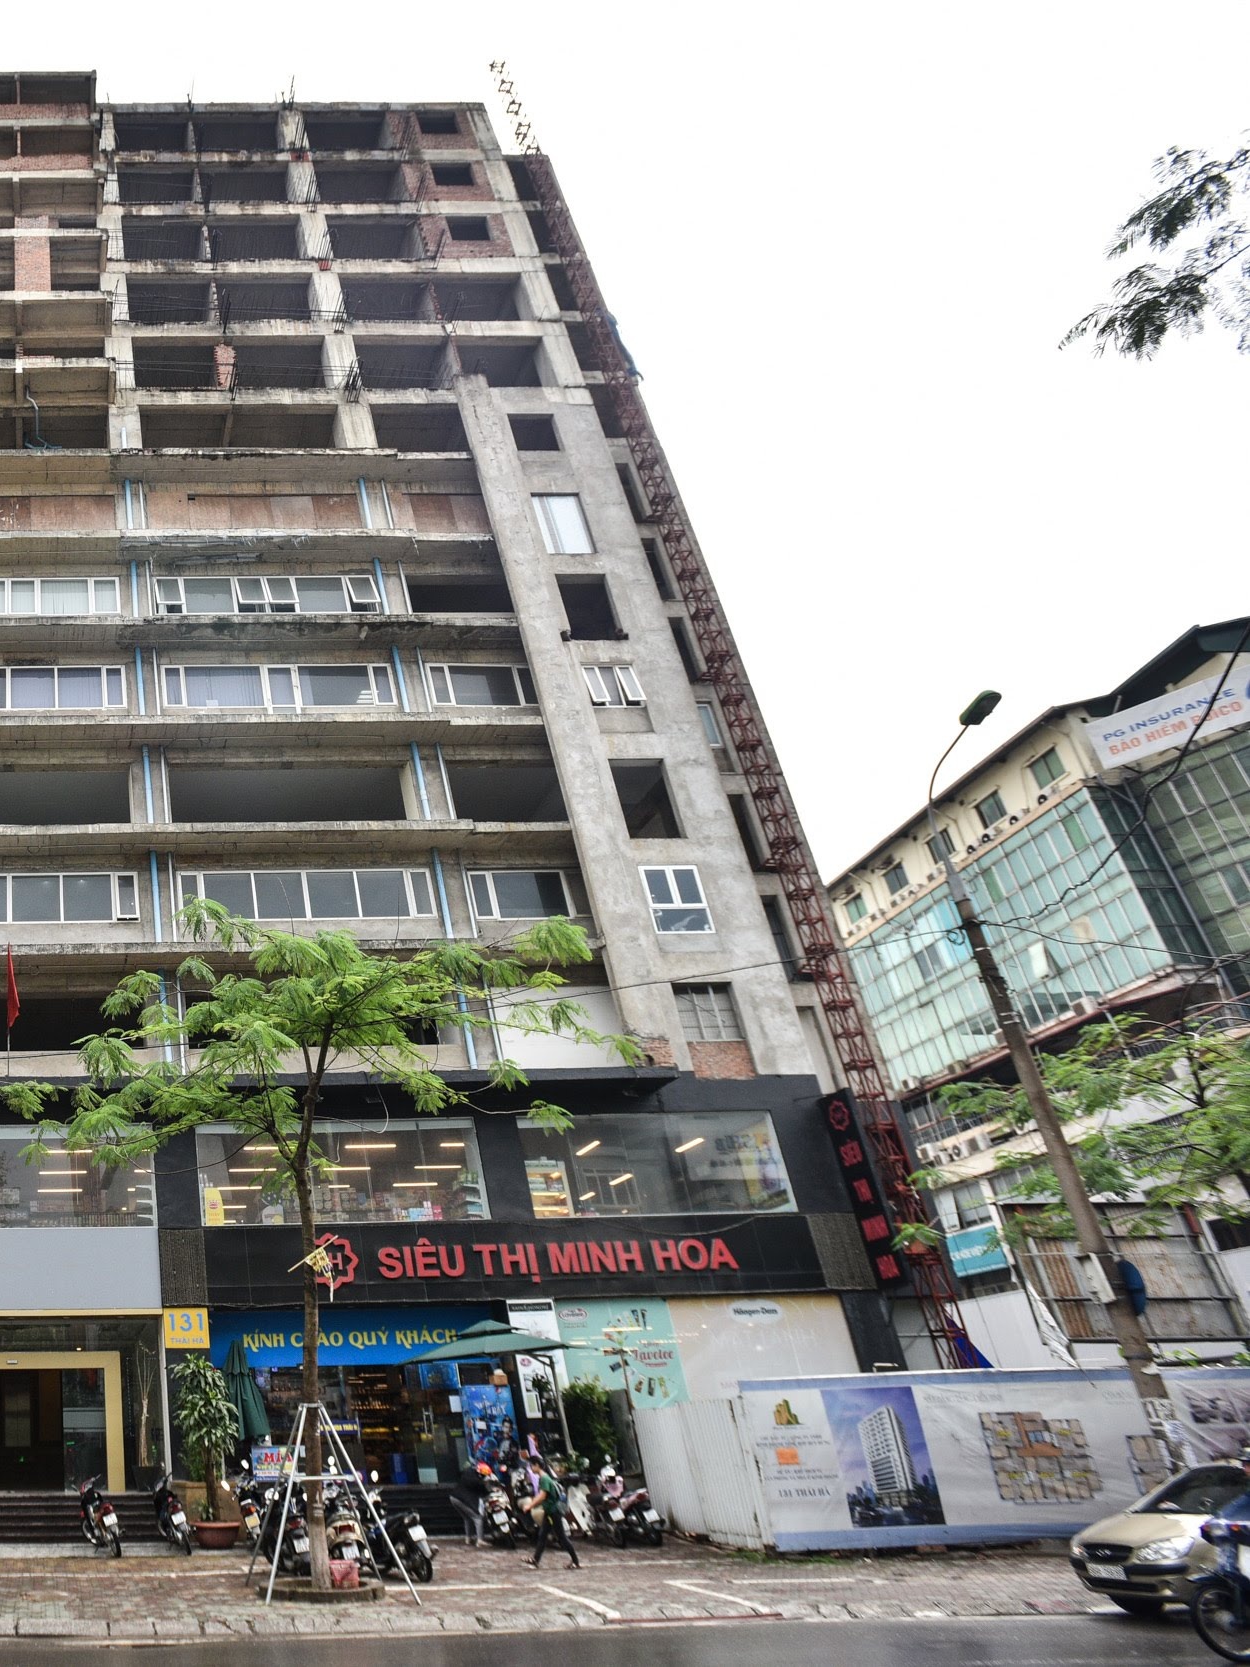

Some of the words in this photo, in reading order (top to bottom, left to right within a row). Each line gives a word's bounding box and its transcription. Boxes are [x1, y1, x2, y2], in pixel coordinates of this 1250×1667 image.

[1103, 730, 1126, 742] PG
[1130, 688, 1235, 732] INSURANE
[378, 1237, 466, 1279] SIÊU
[473, 1243, 541, 1283] THỊ
[546, 1239, 645, 1275] MINH
[651, 1238, 739, 1272] HOA
[168, 1312, 203, 1332] 131
[243, 1329, 284, 1352] KÍNH
[289, 1328, 343, 1348] CÀO
